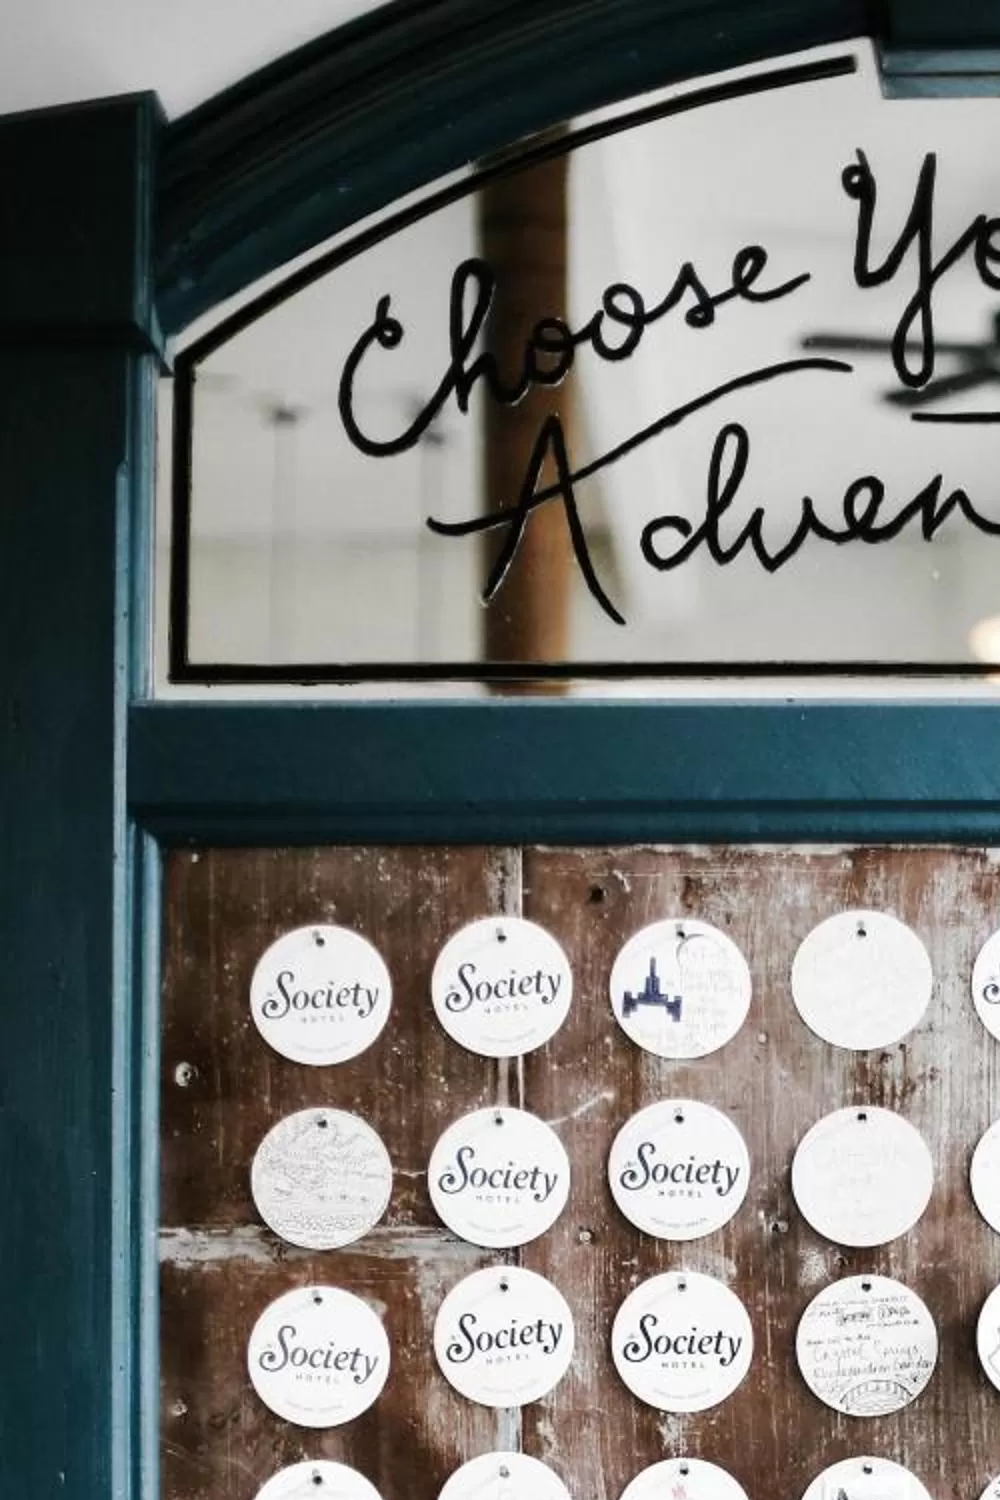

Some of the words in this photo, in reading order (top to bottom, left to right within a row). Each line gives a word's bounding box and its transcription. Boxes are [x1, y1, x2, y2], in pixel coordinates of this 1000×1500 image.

[340, 246, 811, 456] Choose
[261, 971, 378, 1019] Society
[445, 963, 562, 1012] Society
[438, 1146, 558, 1201] Society
[619, 1142, 740, 1197] Society
[259, 1325, 378, 1383] Society
[446, 1313, 563, 1363] Society
[622, 1313, 742, 1367] Society
